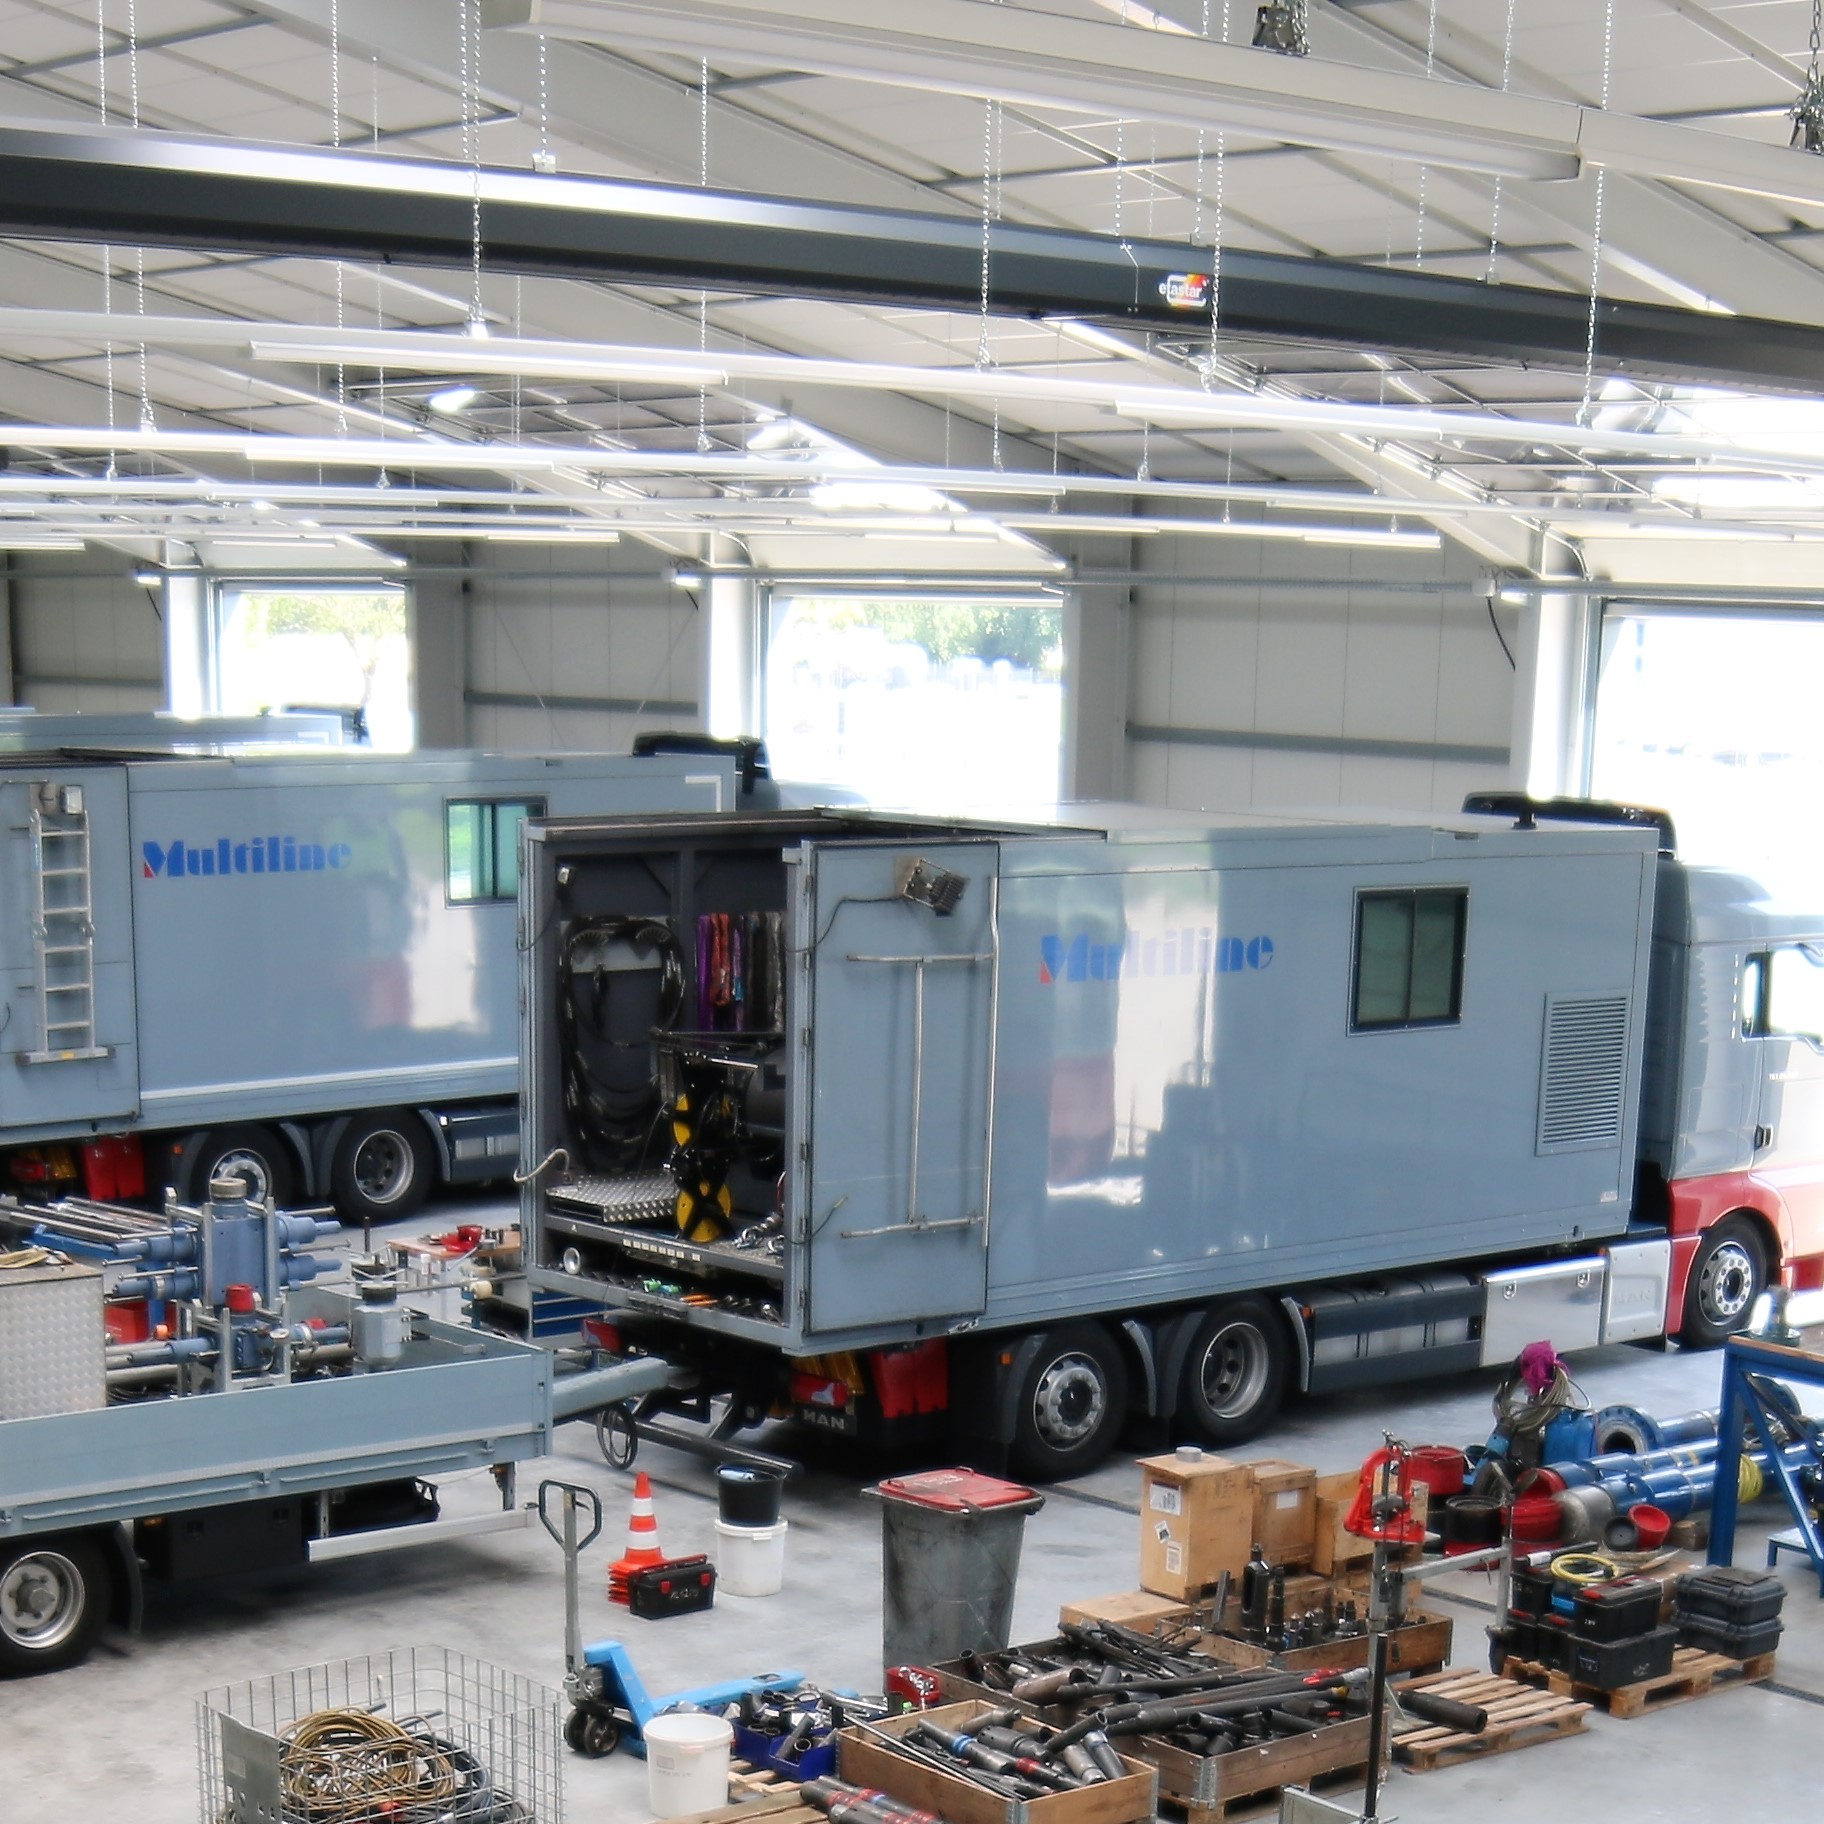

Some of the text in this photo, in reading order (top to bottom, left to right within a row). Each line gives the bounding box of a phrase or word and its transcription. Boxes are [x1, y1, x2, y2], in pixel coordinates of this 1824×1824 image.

[143, 835, 353, 879] Multiline
[1040, 926, 1275, 985] Multiline
[803, 1409, 845, 1430] MAN
